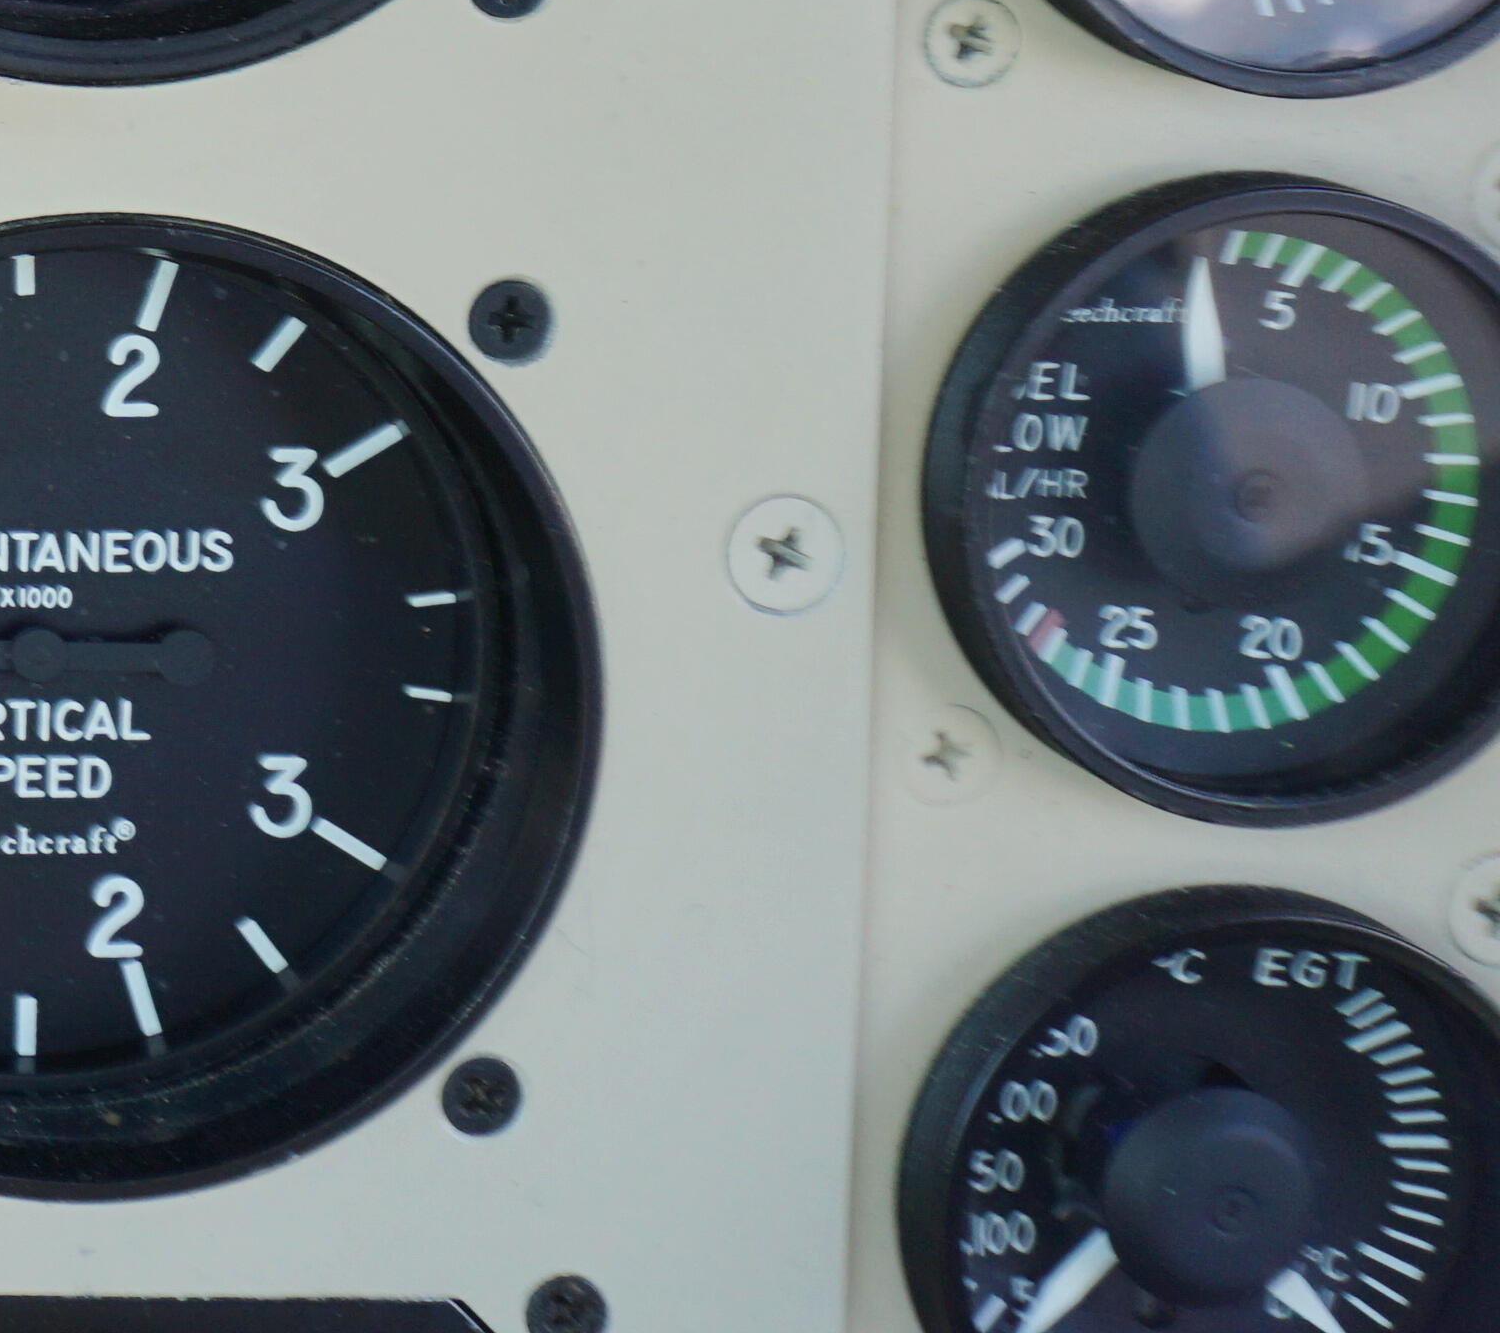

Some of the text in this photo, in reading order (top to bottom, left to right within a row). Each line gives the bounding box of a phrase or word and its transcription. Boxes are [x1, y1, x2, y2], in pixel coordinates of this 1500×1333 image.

[1258, 290, 1297, 331] 5
[102, 334, 161, 418] 2
[1347, 382, 1401, 424] 10
[261, 446, 325, 533] 3
[1026, 516, 1084, 559] 30
[1100, 605, 1158, 651] 25
[1239, 616, 1303, 662] 20
[248, 753, 313, 839] 3
[86, 875, 145, 959] 2
[1254, 948, 1372, 990] EGT
